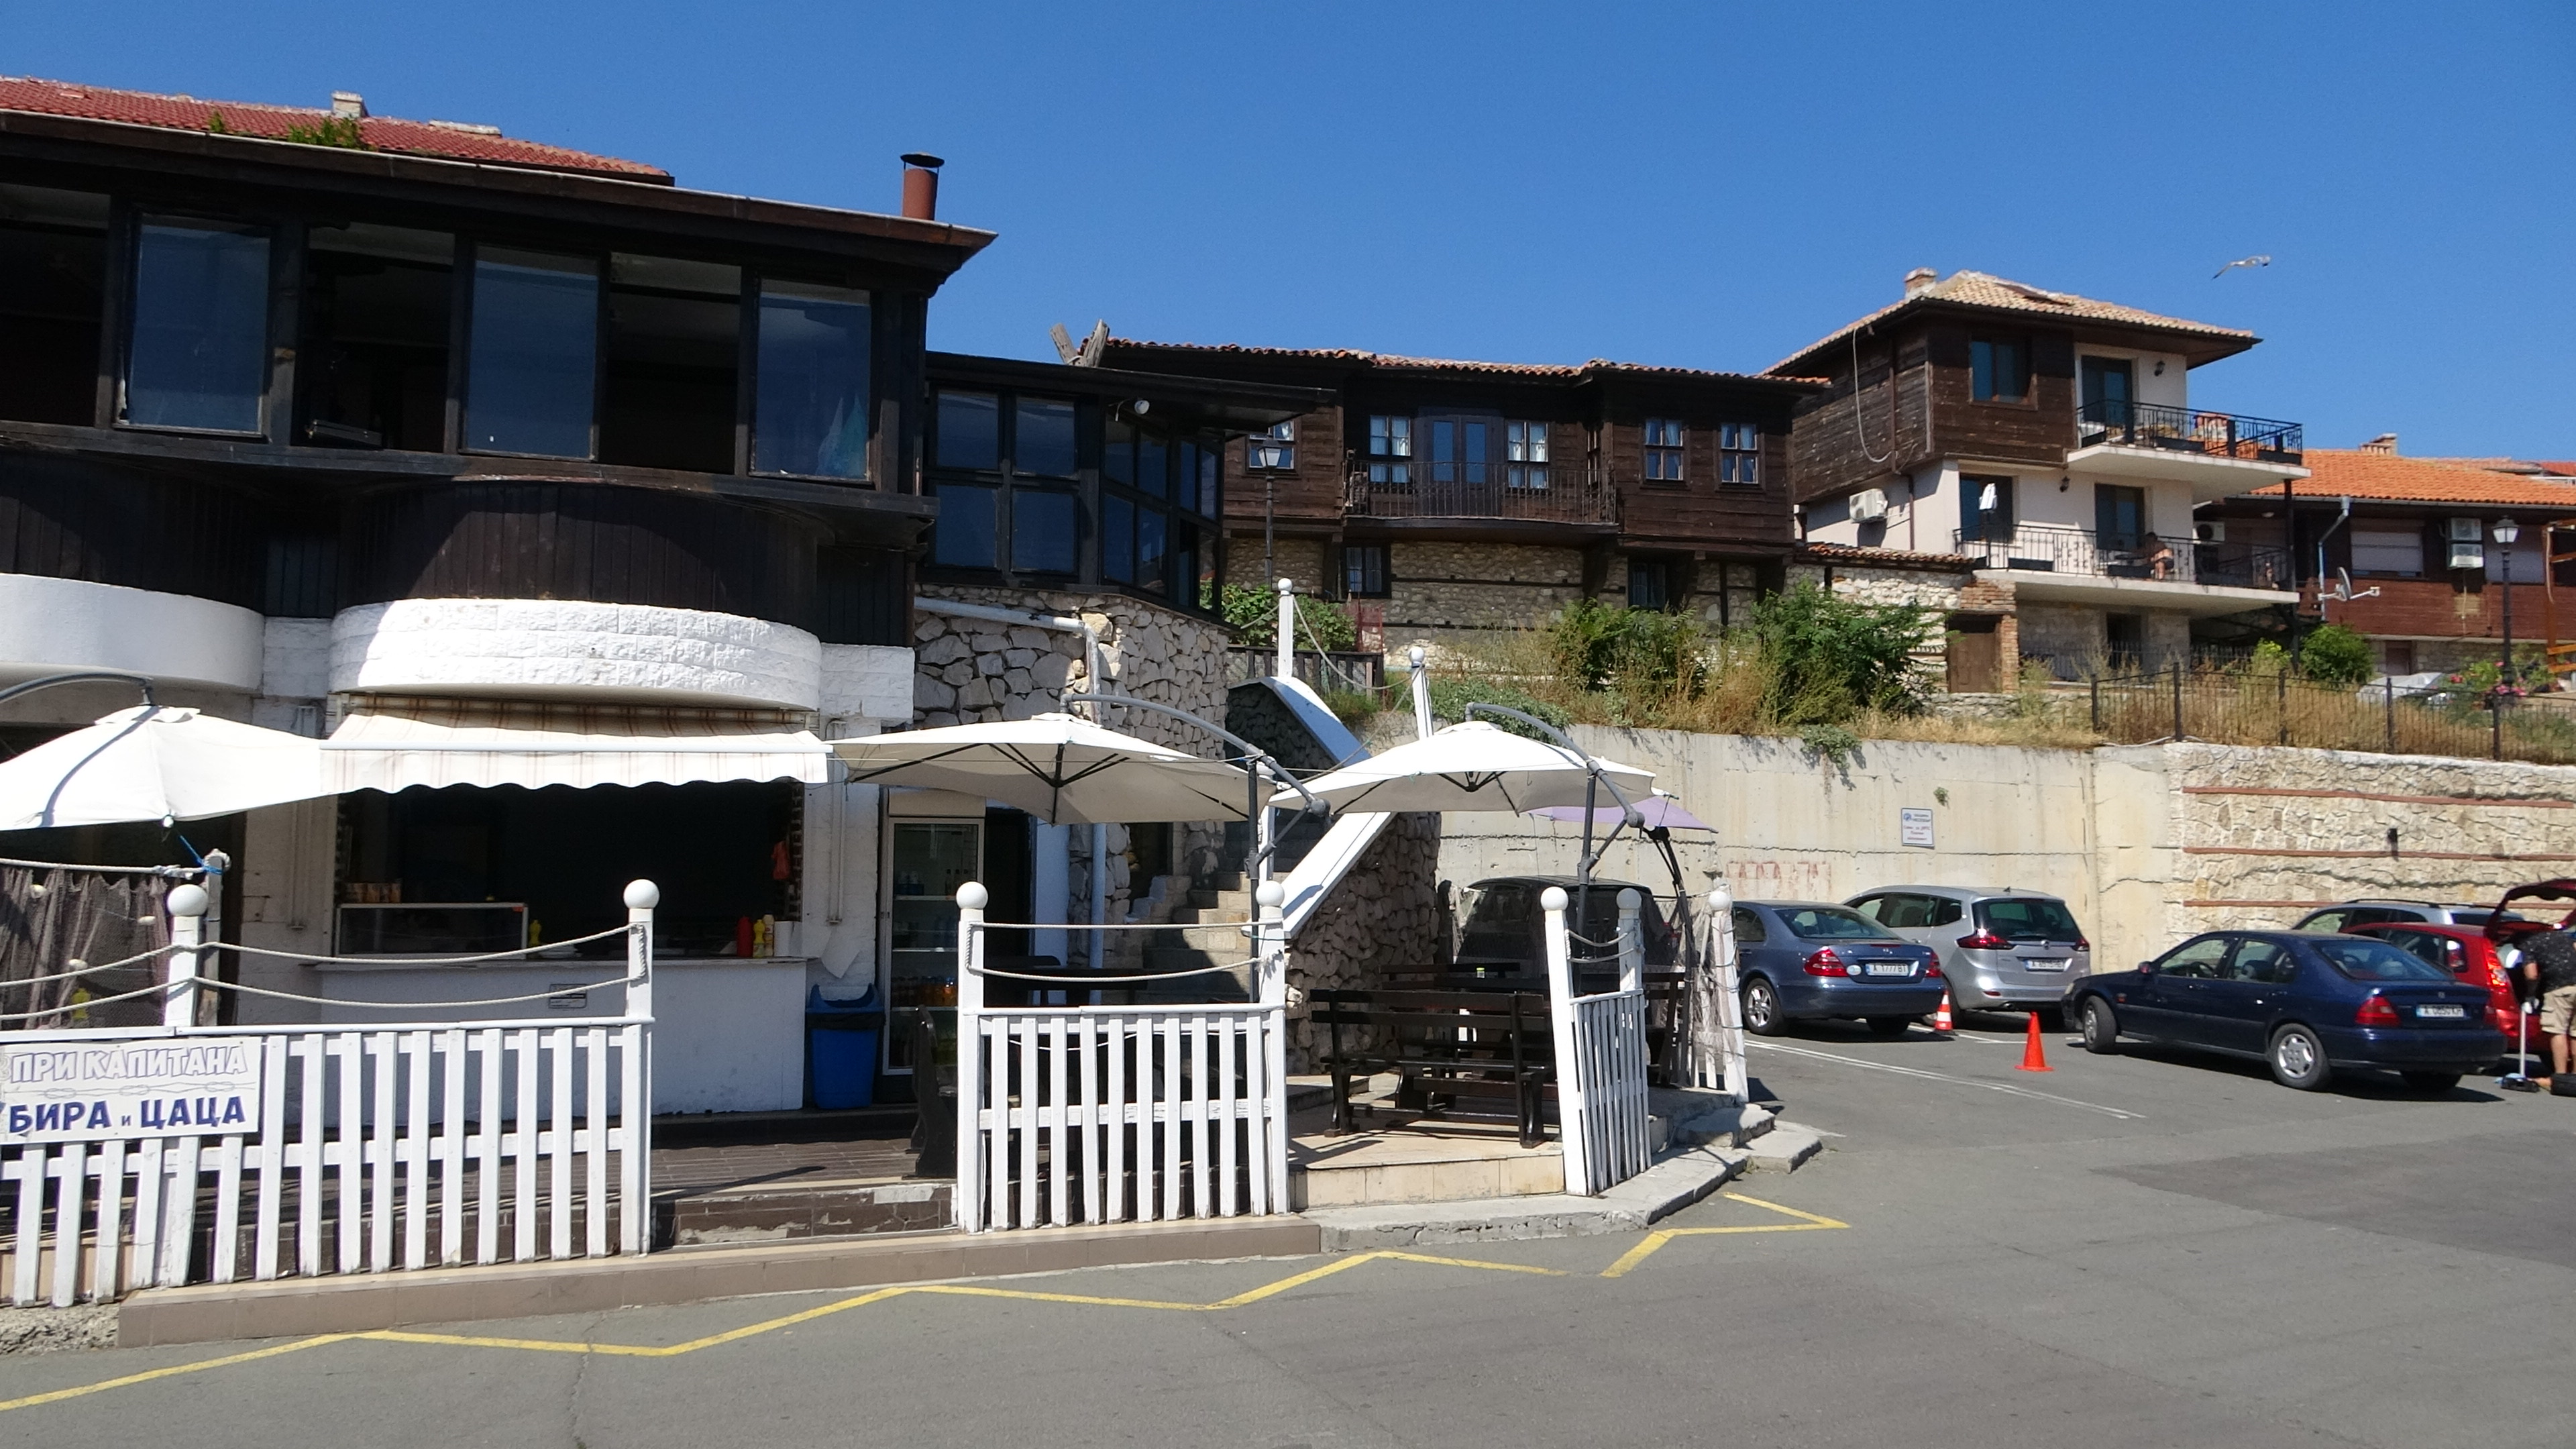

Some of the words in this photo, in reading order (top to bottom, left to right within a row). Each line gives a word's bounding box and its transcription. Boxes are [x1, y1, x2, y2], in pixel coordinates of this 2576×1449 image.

[11, 1051, 78, 1083] ПРИ
[83, 1046, 248, 1080] КАПИТАНА
[9, 1100, 113, 1134] БИРА
[140, 1095, 246, 1130] ЦАЦА
